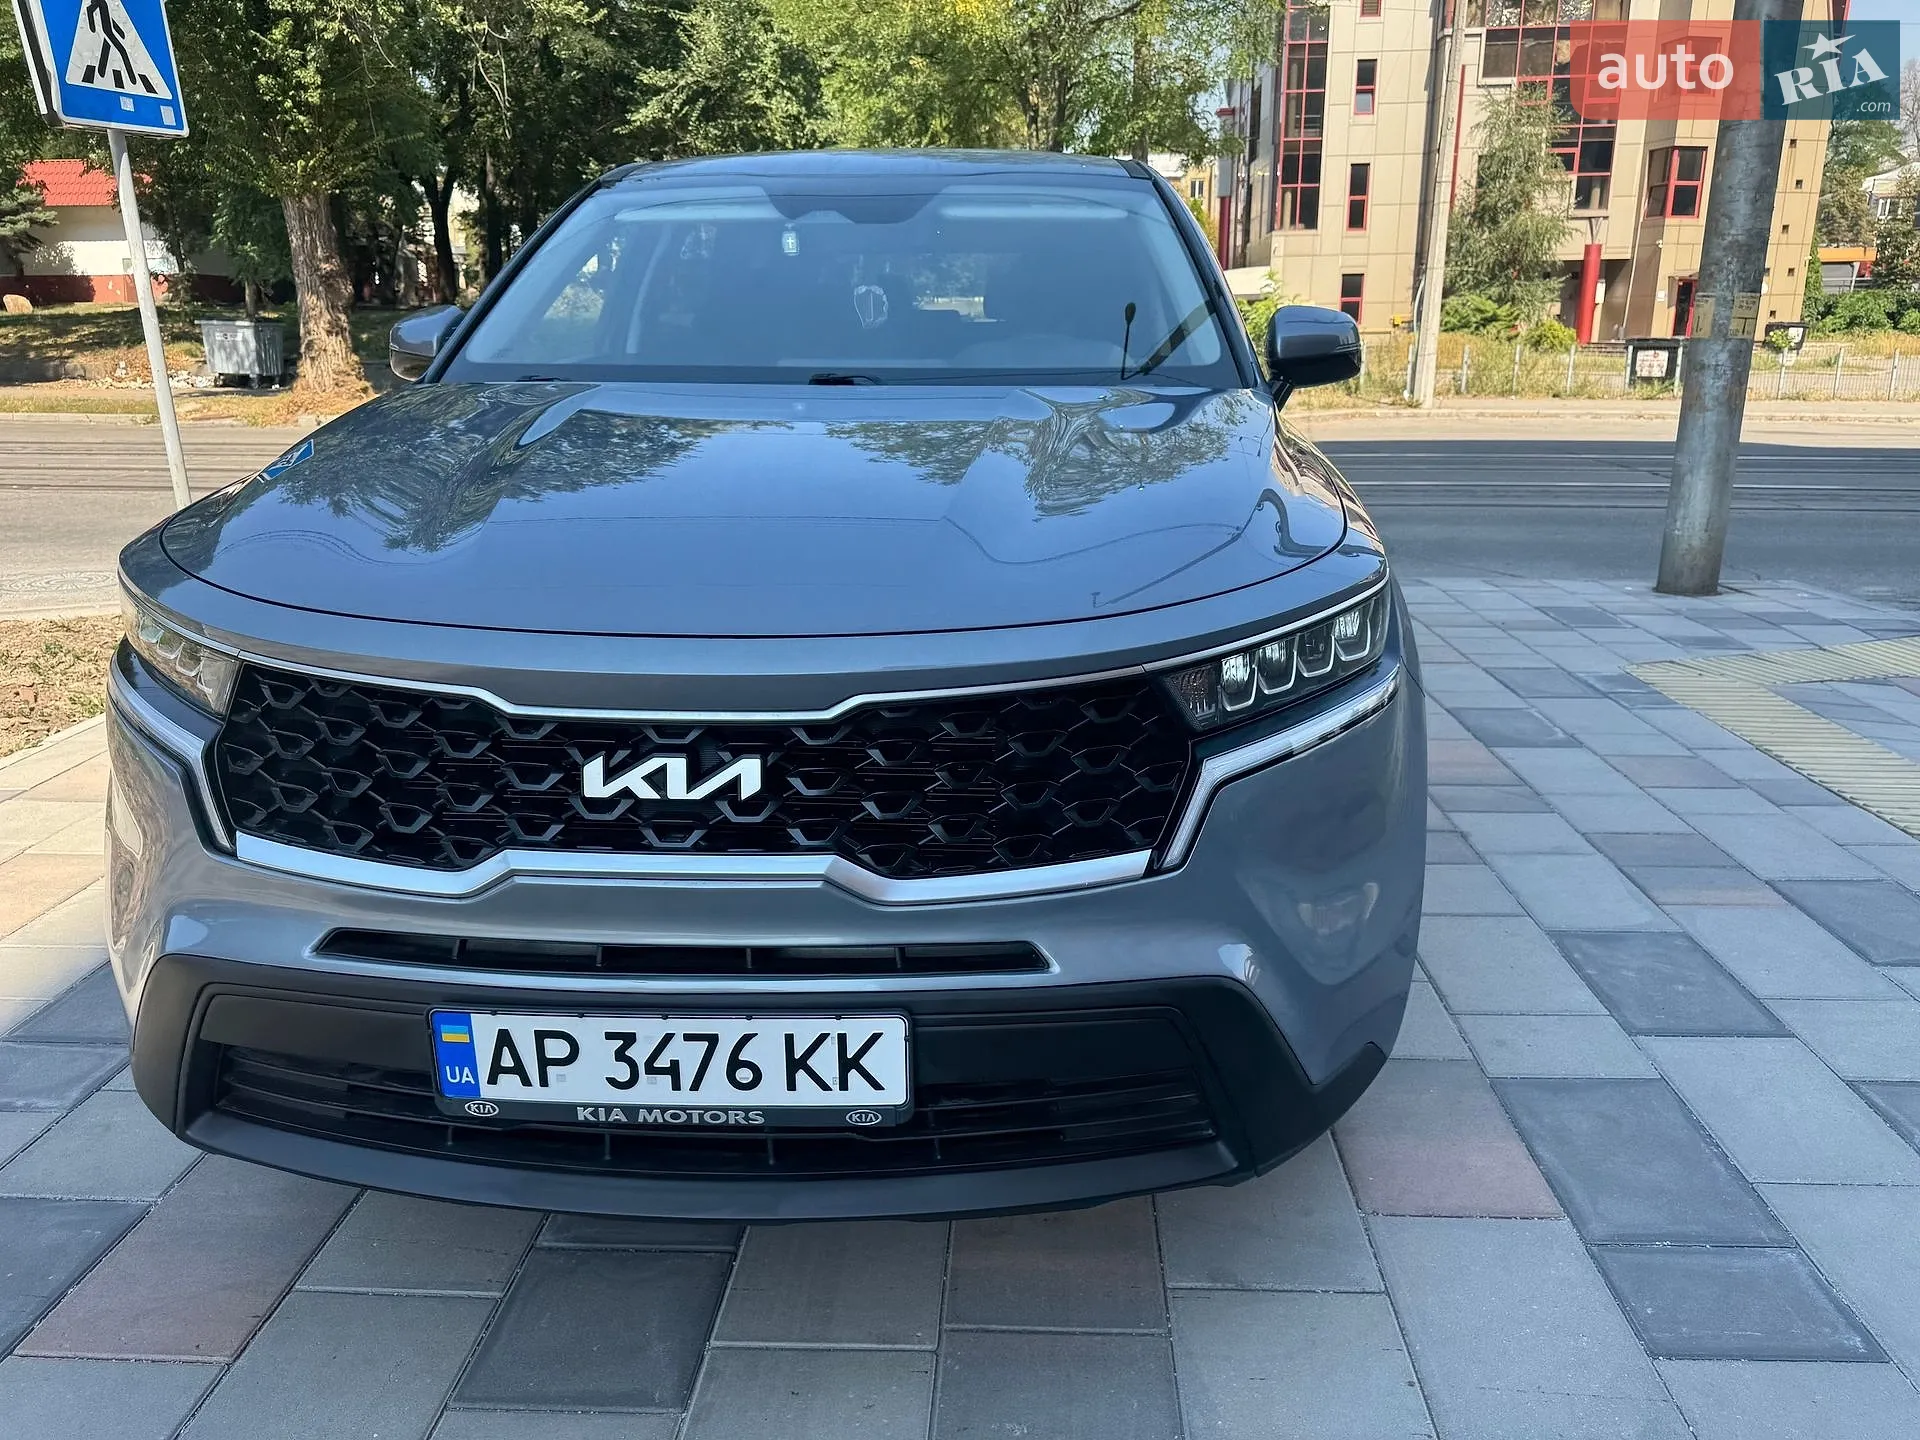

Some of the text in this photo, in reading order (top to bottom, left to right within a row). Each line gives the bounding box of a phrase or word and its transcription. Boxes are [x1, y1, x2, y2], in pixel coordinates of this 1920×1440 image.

[583, 751, 763, 801] KIA
[486, 1028, 886, 1092] AP 3476 KK
[446, 1066, 475, 1084] UA
[469, 1103, 495, 1114] KIA
[577, 1106, 765, 1124] KIA MOTORS
[852, 1112, 877, 1123] KIA
